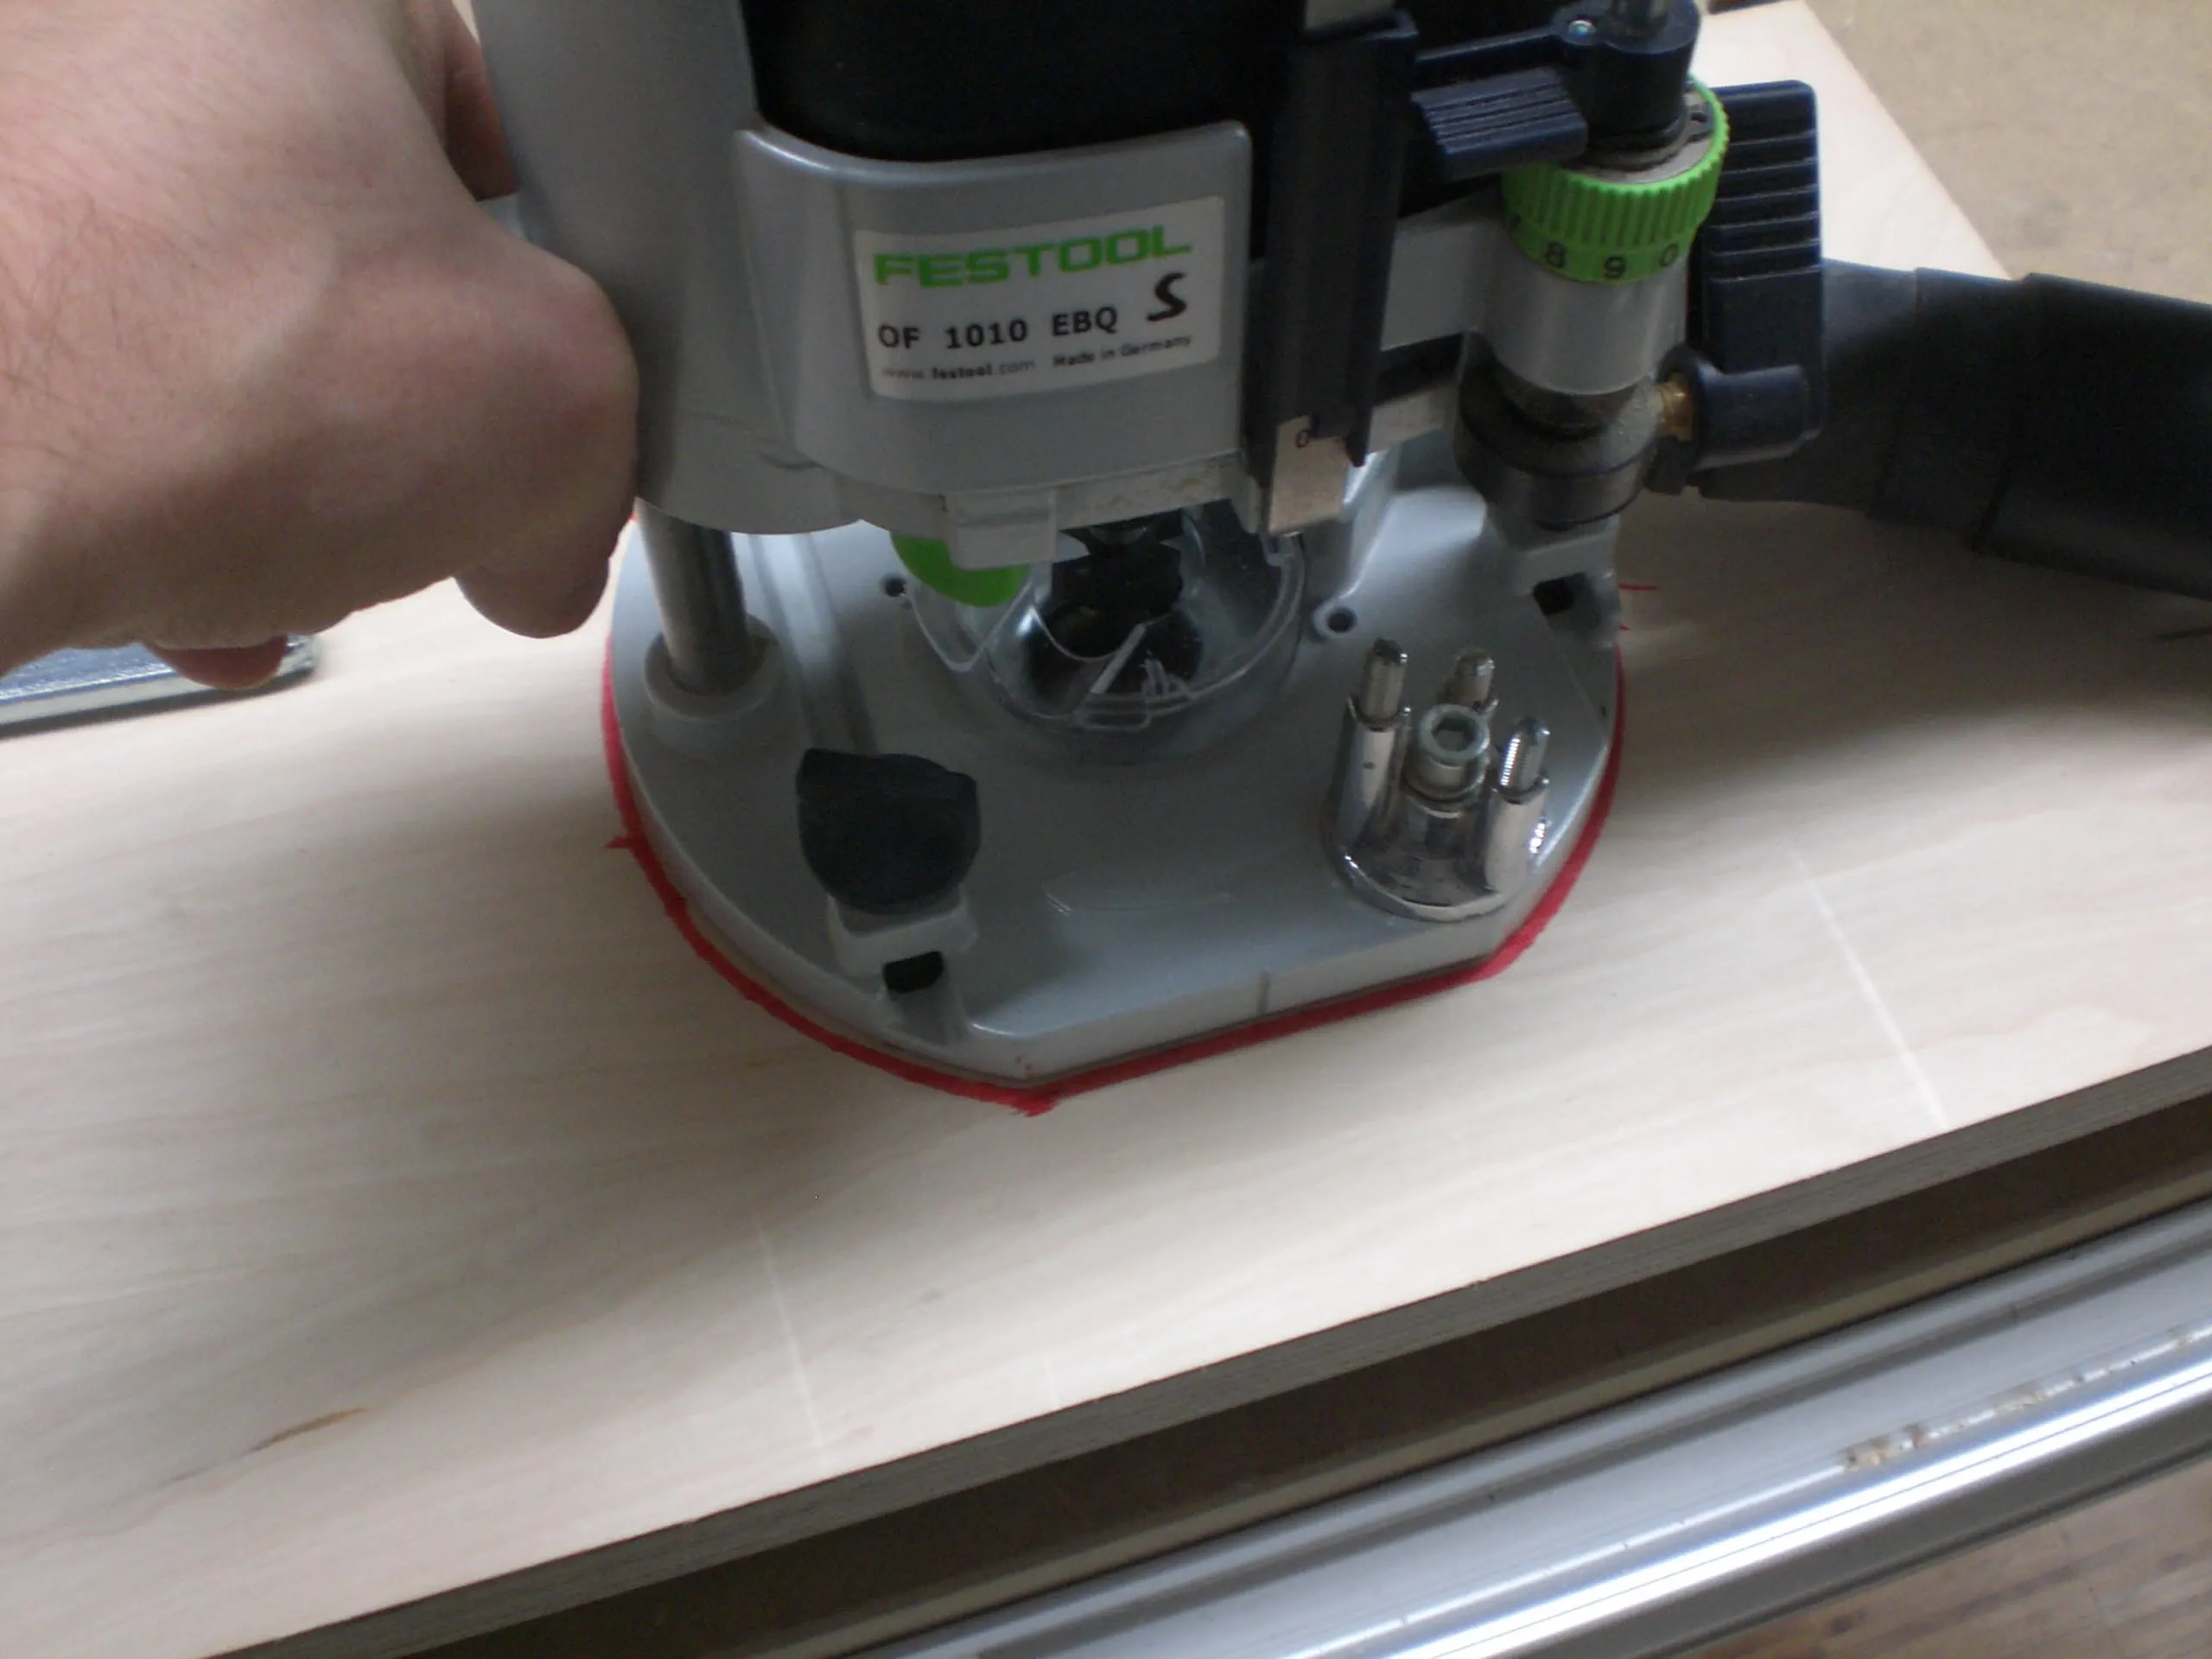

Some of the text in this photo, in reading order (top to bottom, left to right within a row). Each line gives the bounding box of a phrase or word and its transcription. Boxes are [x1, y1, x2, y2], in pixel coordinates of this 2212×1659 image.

[874, 226, 1192, 289] FESTOOL
[1545, 241, 1567, 269] 8
[1604, 257, 1626, 279] 9
[1146, 271, 1187, 322] S
[878, 306, 1118, 349] OF 1010 EBQ
[1052, 353, 1095, 368] Made
[1101, 347, 1116, 360] in
[1120, 335, 1192, 357] Germany
